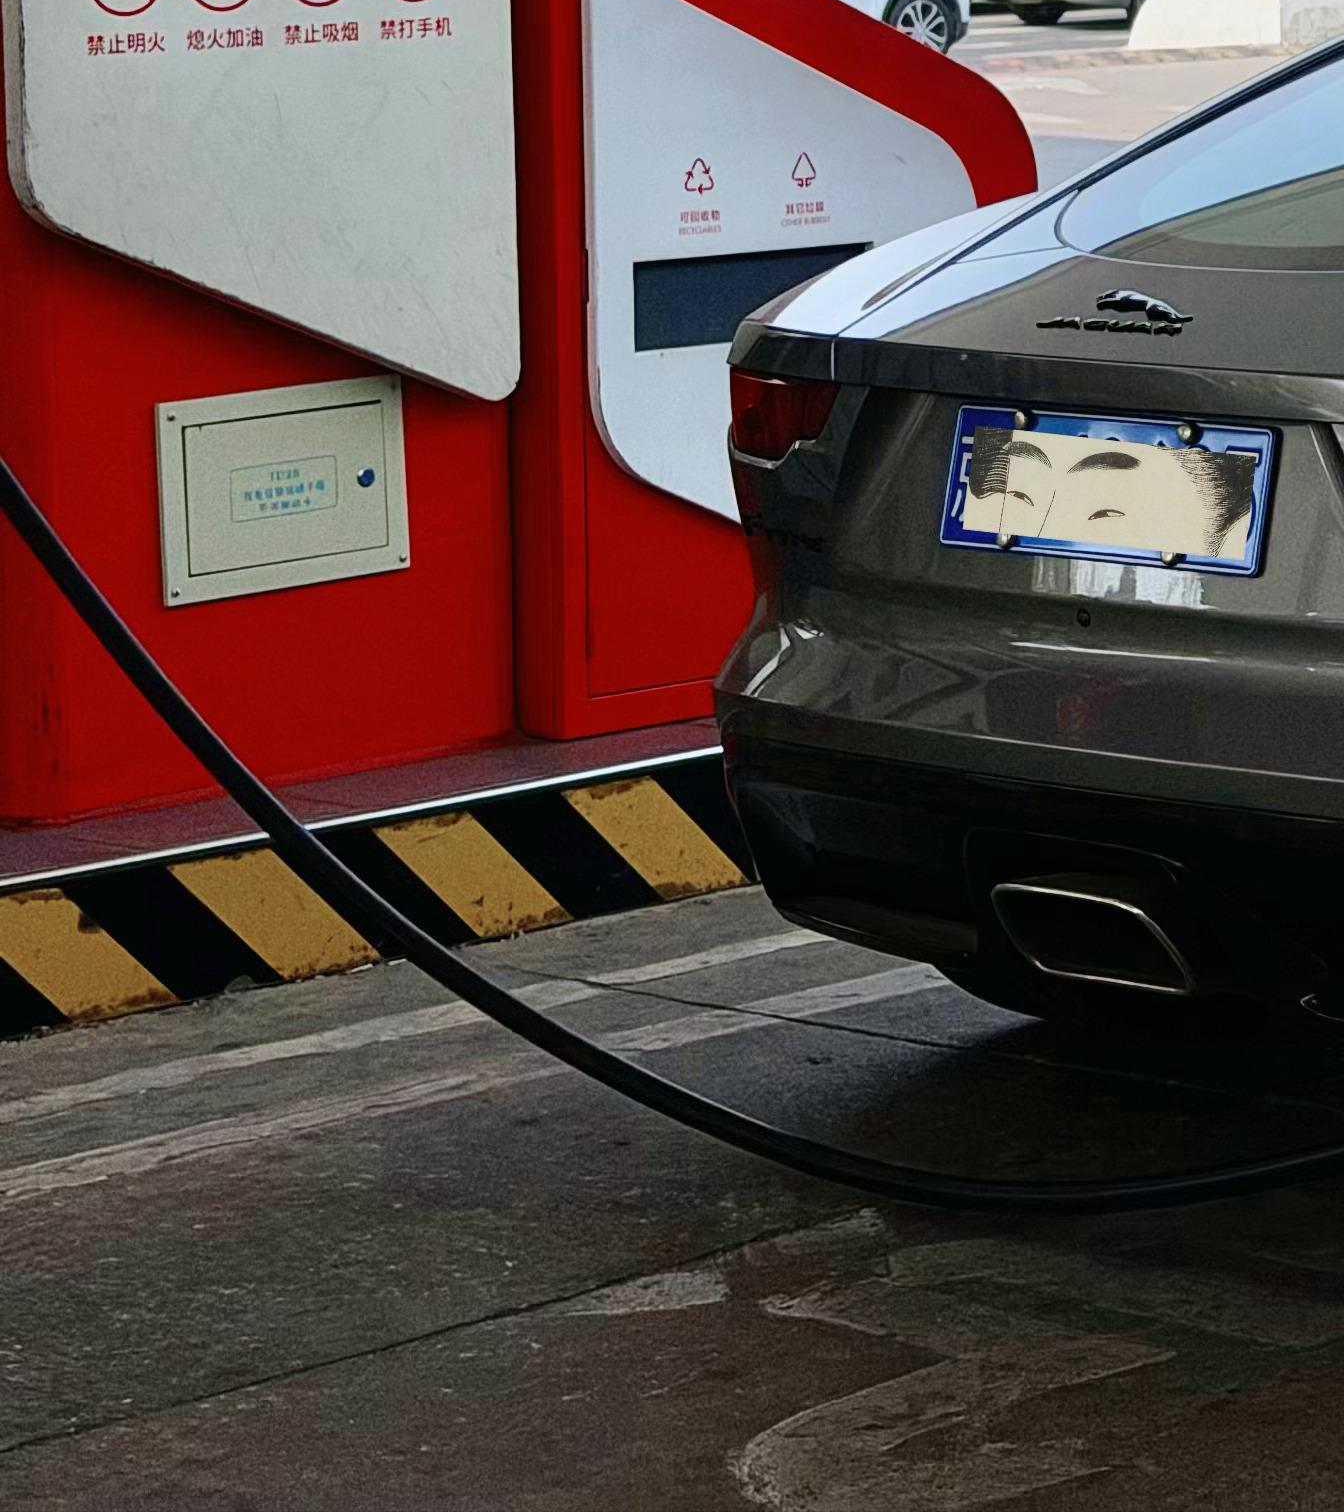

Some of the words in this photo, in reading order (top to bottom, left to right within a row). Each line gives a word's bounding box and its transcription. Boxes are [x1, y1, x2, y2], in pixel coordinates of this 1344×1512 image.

[185, 27, 265, 51] 熄火加油
[284, 21, 359, 45] 禁止吸烟
[379, 17, 453, 40] 禁打手机
[86, 34, 166, 56] 禁止明火
